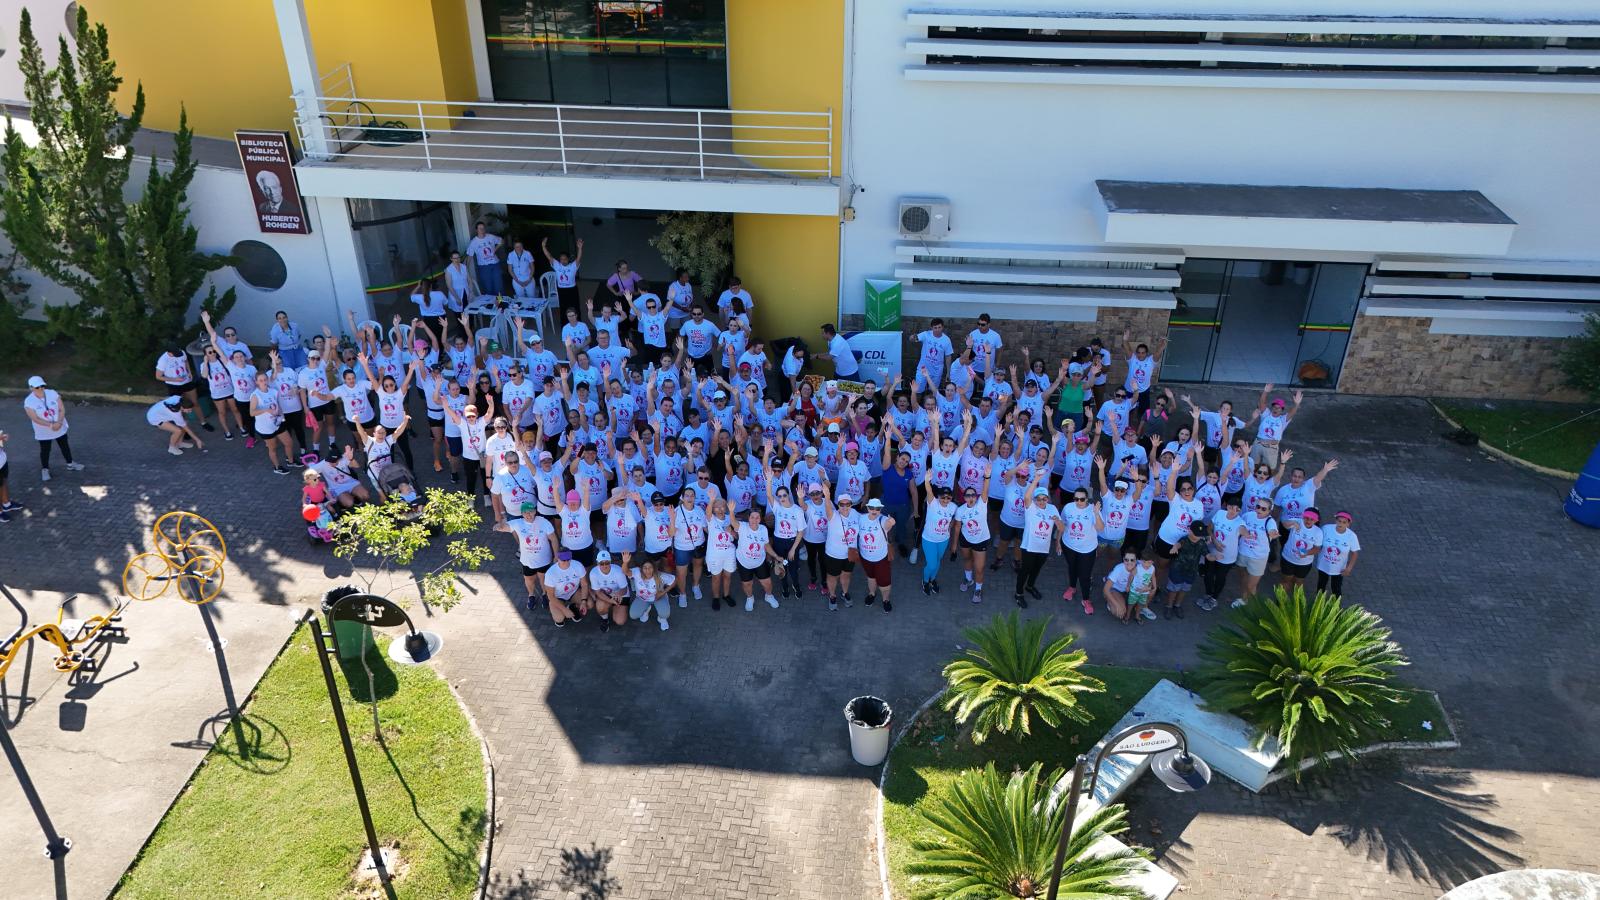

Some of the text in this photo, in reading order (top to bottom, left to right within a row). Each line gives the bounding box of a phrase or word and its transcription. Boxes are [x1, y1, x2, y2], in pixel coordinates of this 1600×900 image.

[248, 146, 280, 154] PÚBLICA
[262, 214, 300, 222] HUBERTO
[864, 350, 886, 360] CDL
